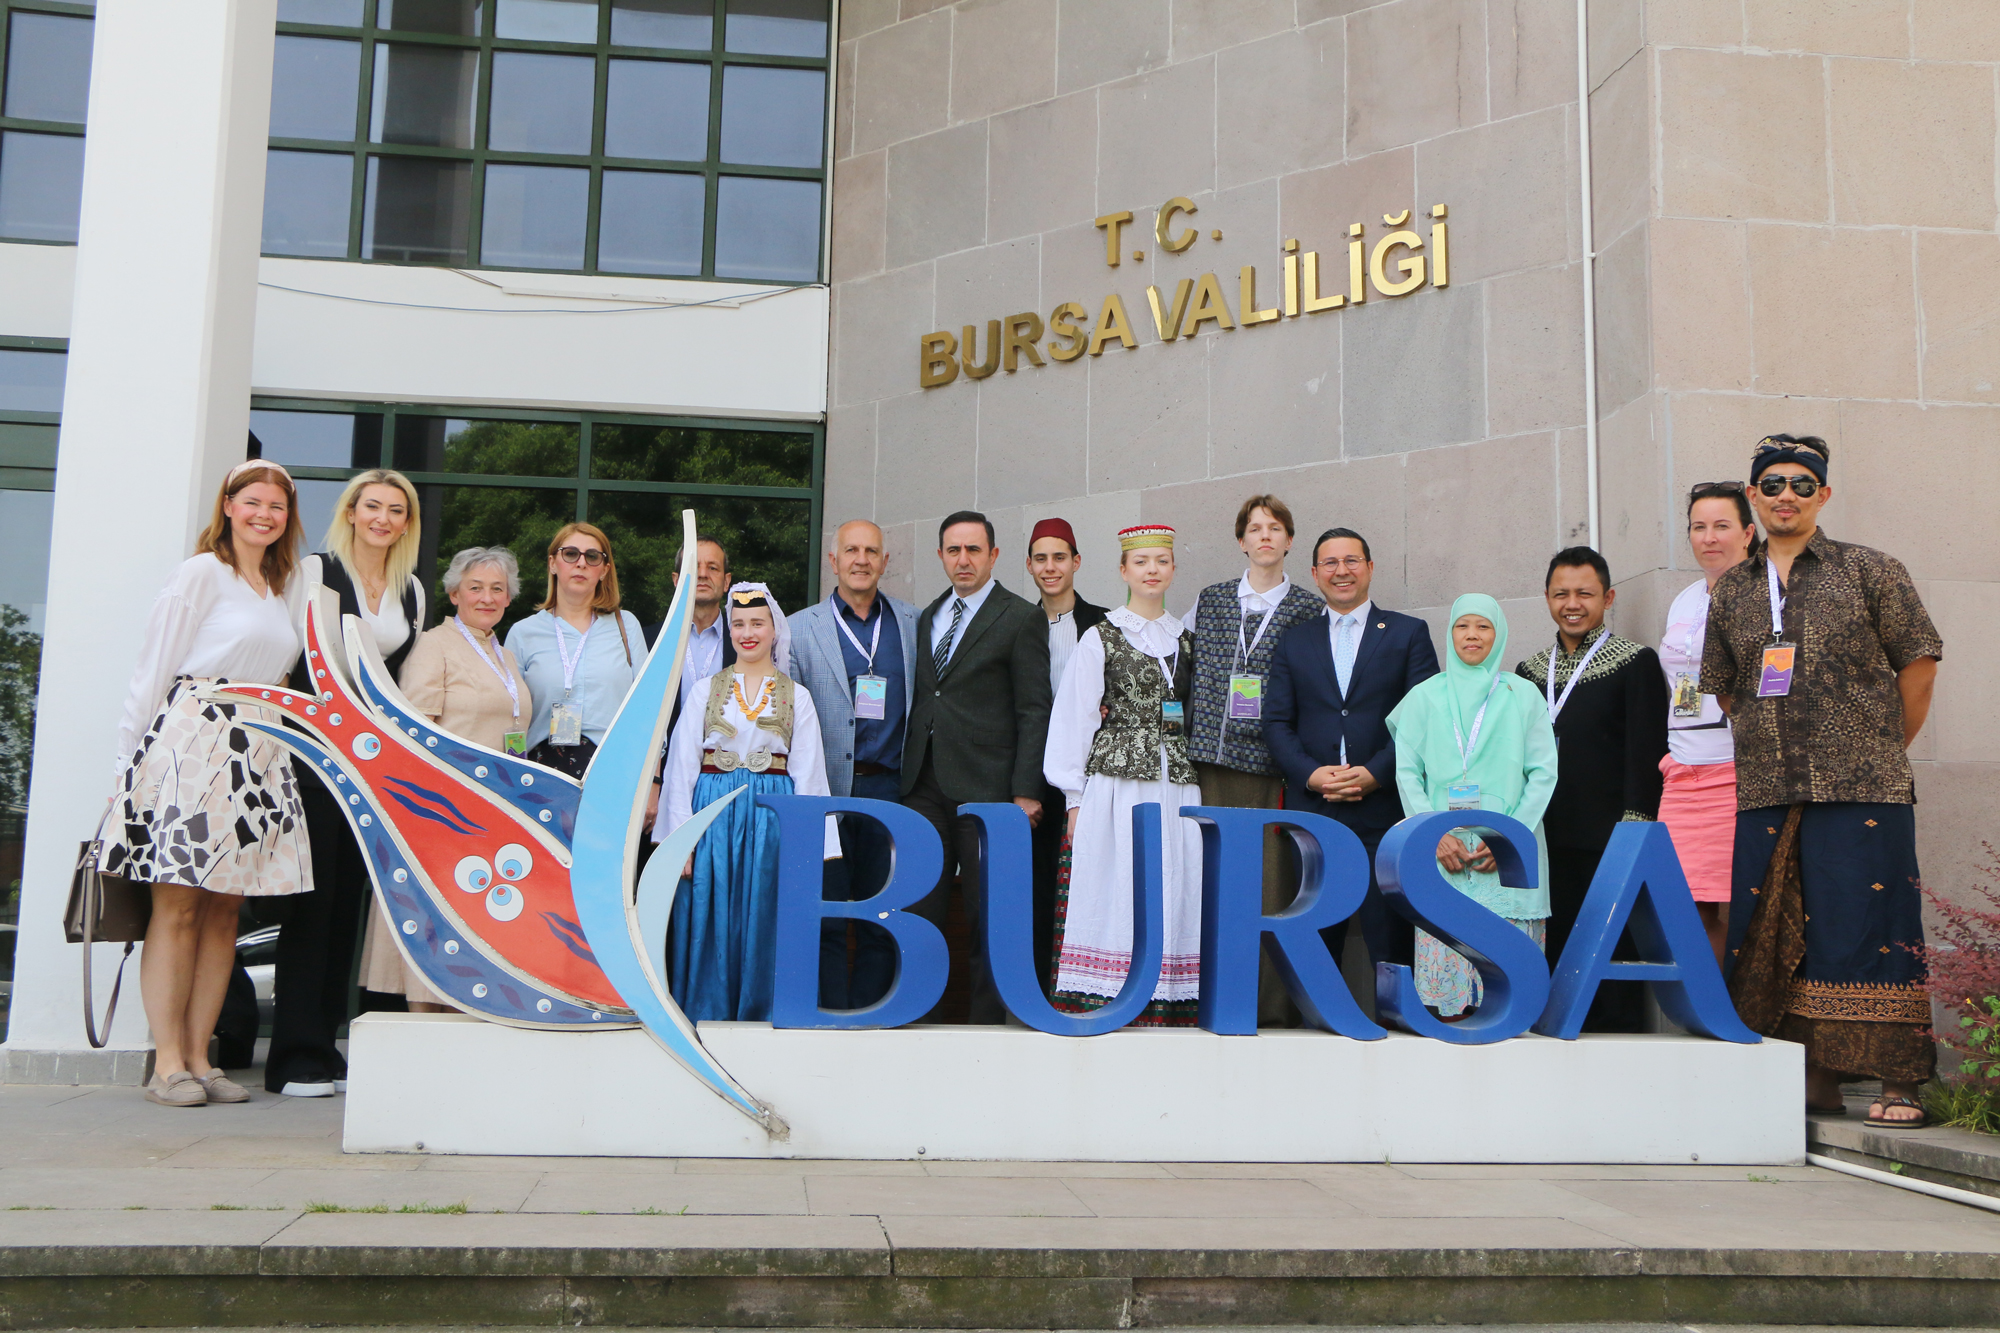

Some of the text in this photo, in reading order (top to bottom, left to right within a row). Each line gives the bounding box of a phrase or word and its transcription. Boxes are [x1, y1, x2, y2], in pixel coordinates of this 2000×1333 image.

[920, 203, 1449, 389] BURSA VALİLİĞİ
[756, 794, 1763, 1044] BURSA
